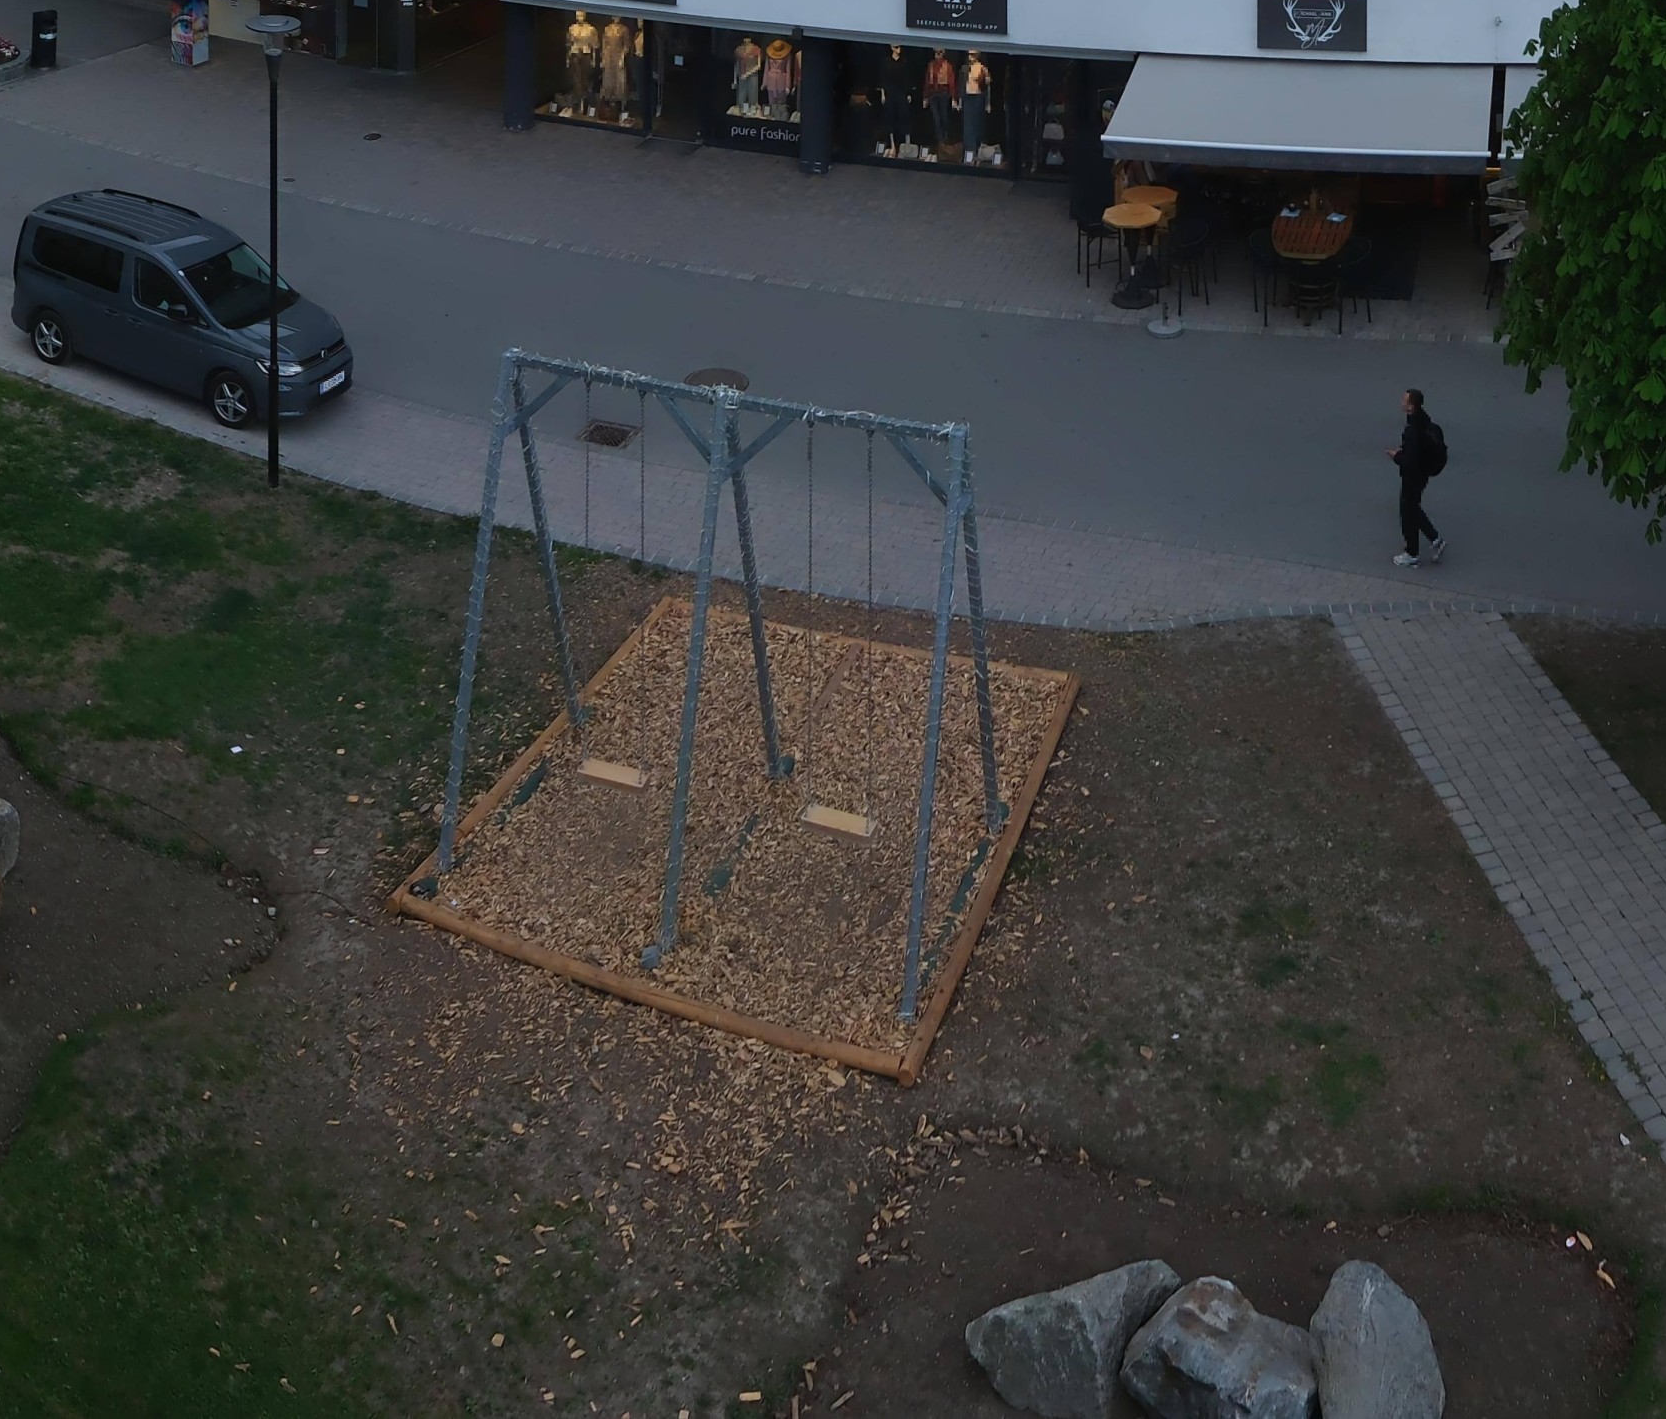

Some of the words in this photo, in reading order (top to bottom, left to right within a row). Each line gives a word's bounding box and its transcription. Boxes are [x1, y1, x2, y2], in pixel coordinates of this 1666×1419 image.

[916, 19, 945, 27] SEEFELD
[947, 21, 982, 30] SHOPPING
[731, 126, 757, 137] pure
